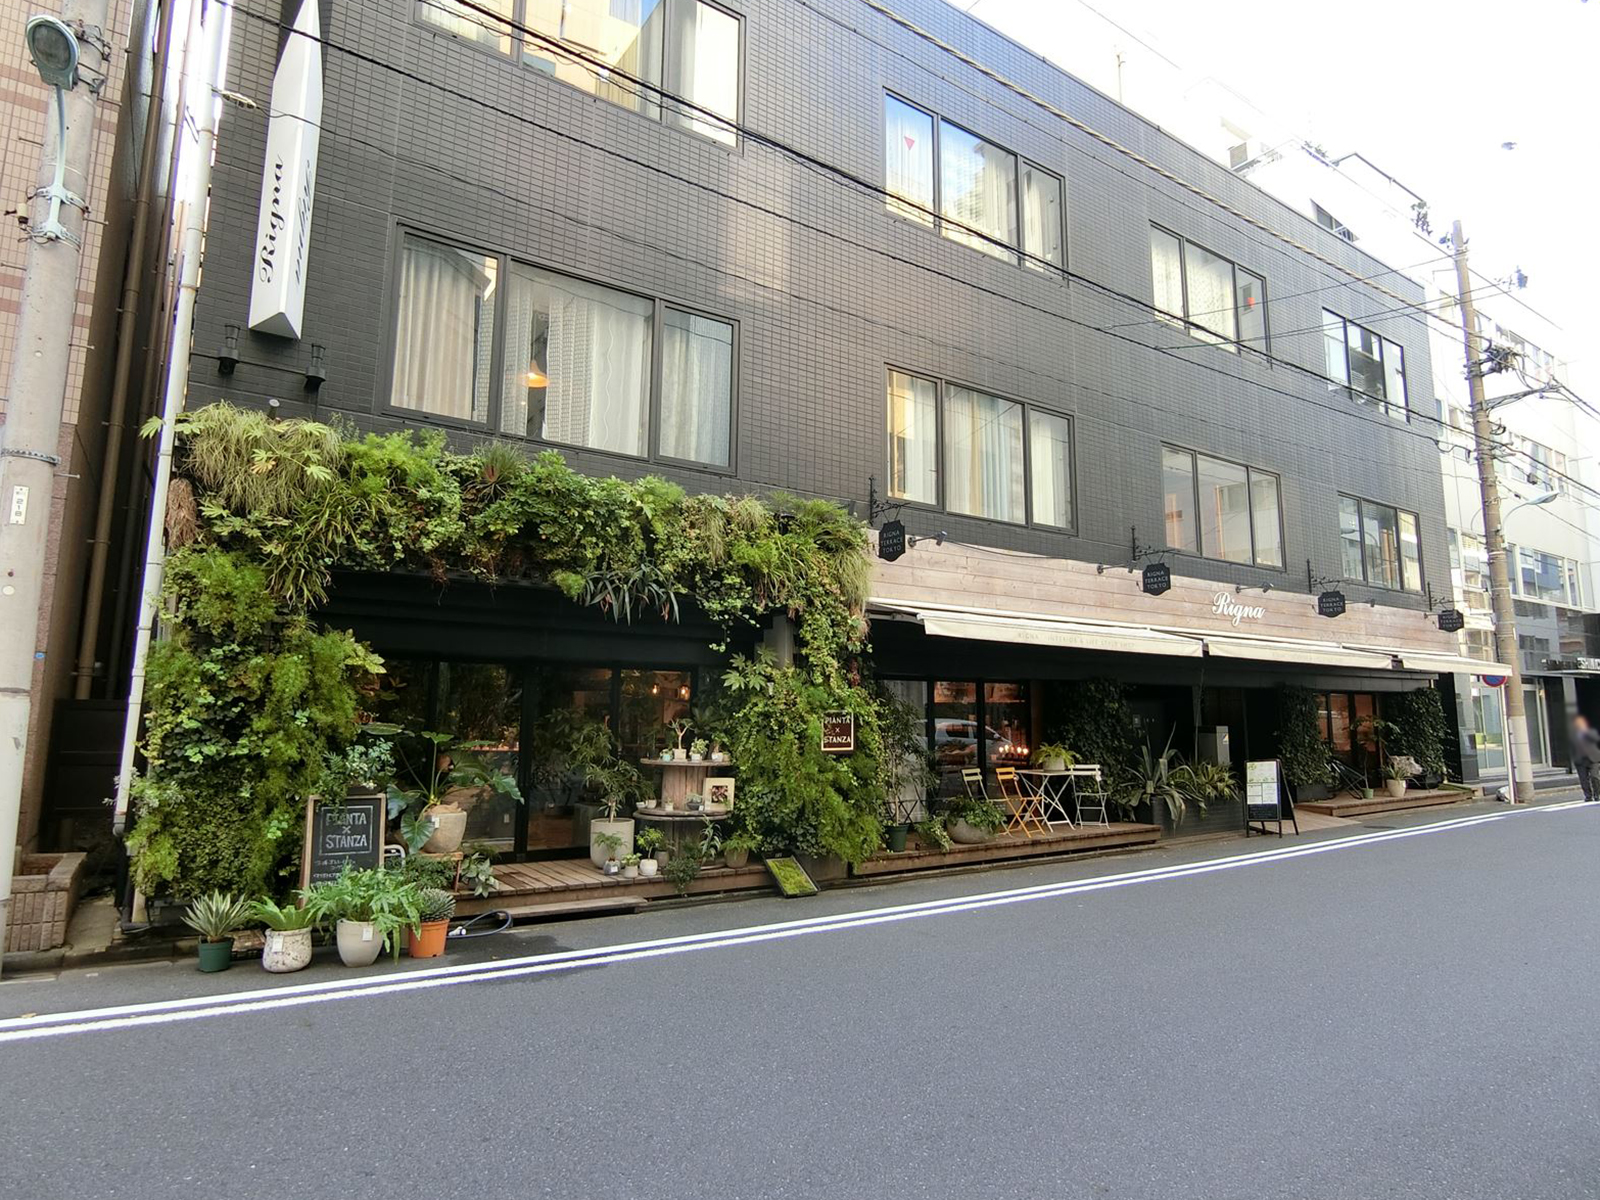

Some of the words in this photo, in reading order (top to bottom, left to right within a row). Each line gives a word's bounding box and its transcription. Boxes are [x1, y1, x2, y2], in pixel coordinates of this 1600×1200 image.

[259, 154, 285, 284] Rigna
[883, 529, 900, 538] RIGNA
[881, 537, 903, 547] TERRACE
[882, 545, 902, 553] TOKYO
[1145, 576, 1168, 584] TERRACE
[1212, 591, 1266, 626] Rigna
[824, 716, 851, 724] PIANTA
[824, 735, 851, 743] STANZA
[325, 834, 368, 849] STANZA
